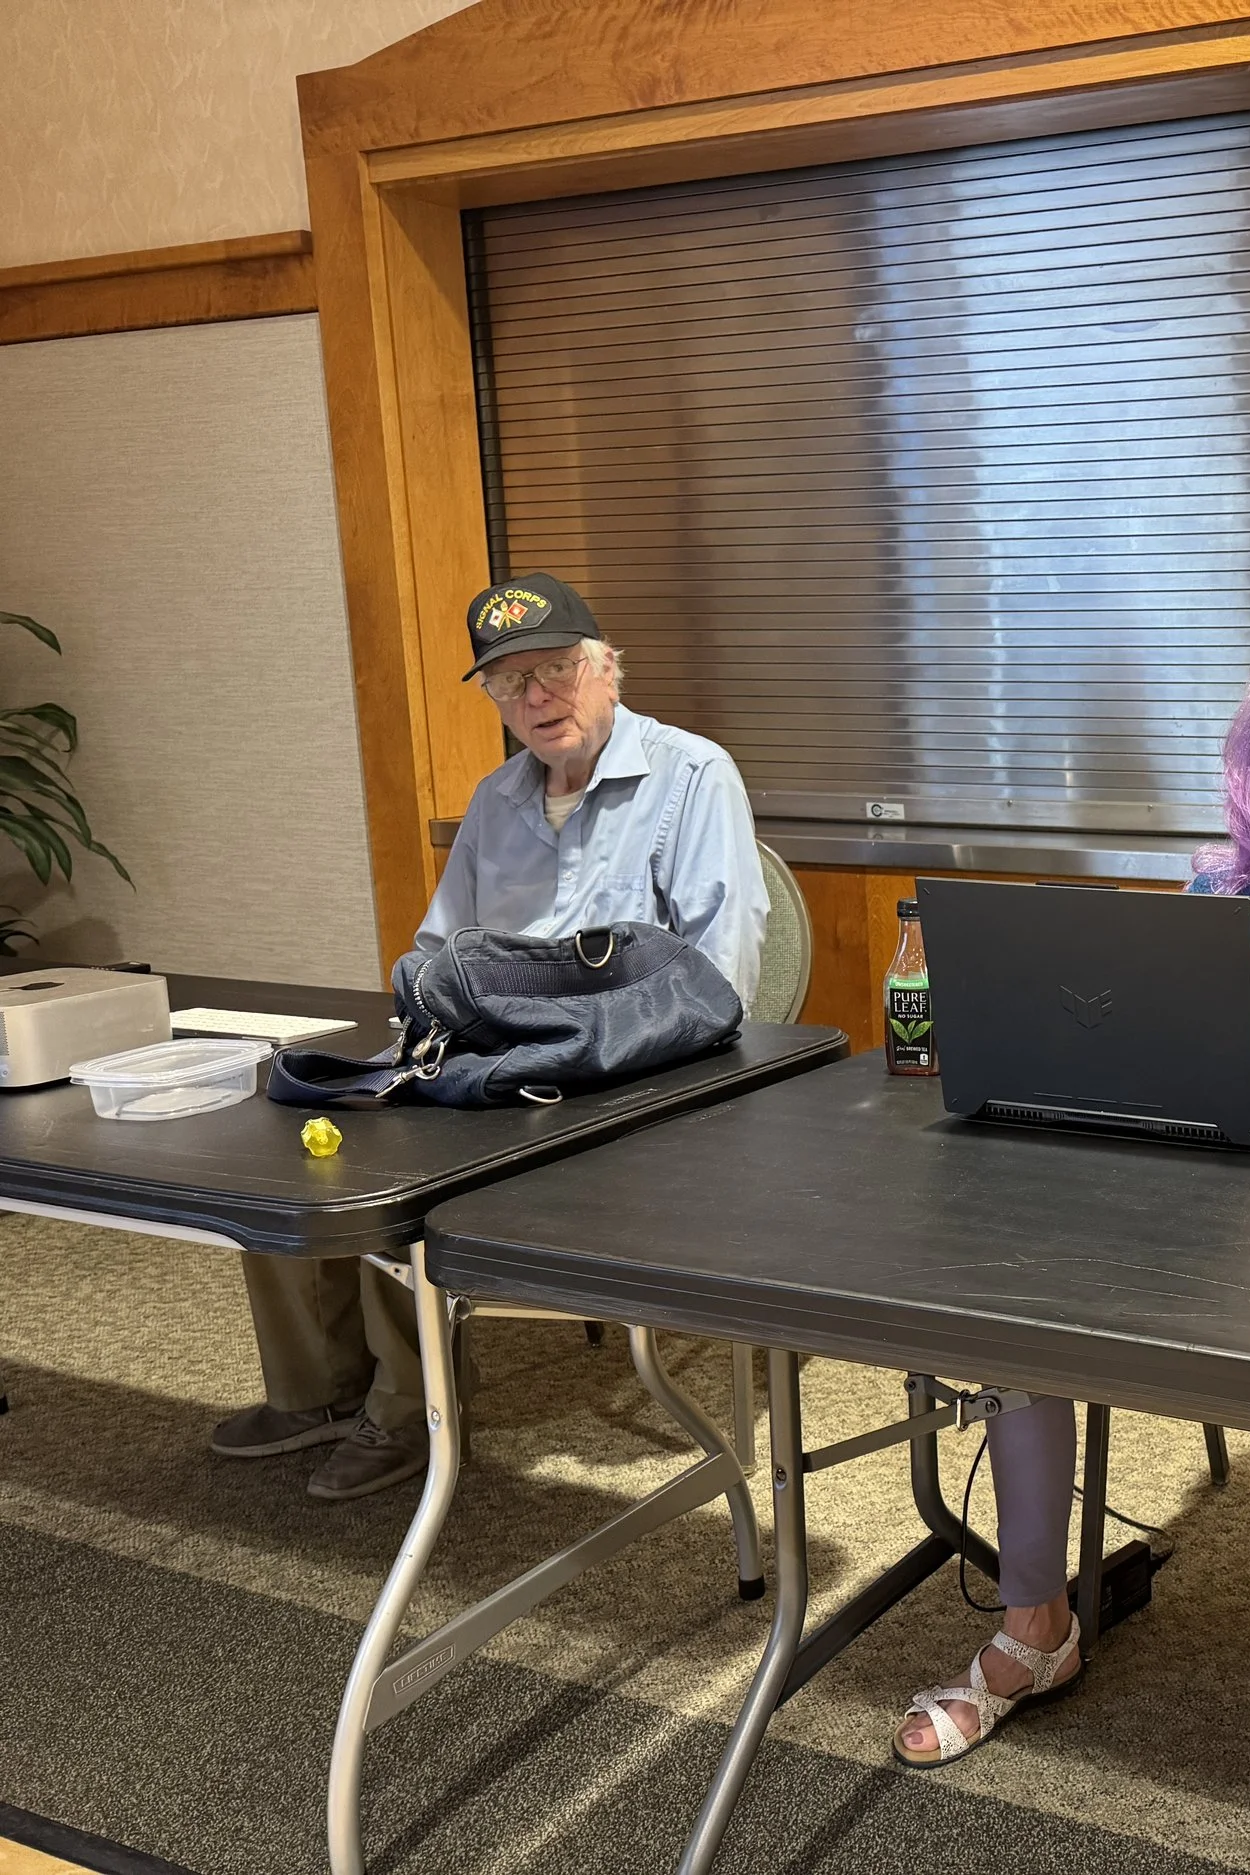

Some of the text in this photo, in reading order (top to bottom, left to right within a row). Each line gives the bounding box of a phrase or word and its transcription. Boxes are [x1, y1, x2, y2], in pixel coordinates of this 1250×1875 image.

[476, 589, 547, 630] SIGNAL CORPS
[893, 991, 927, 1003] PURE
